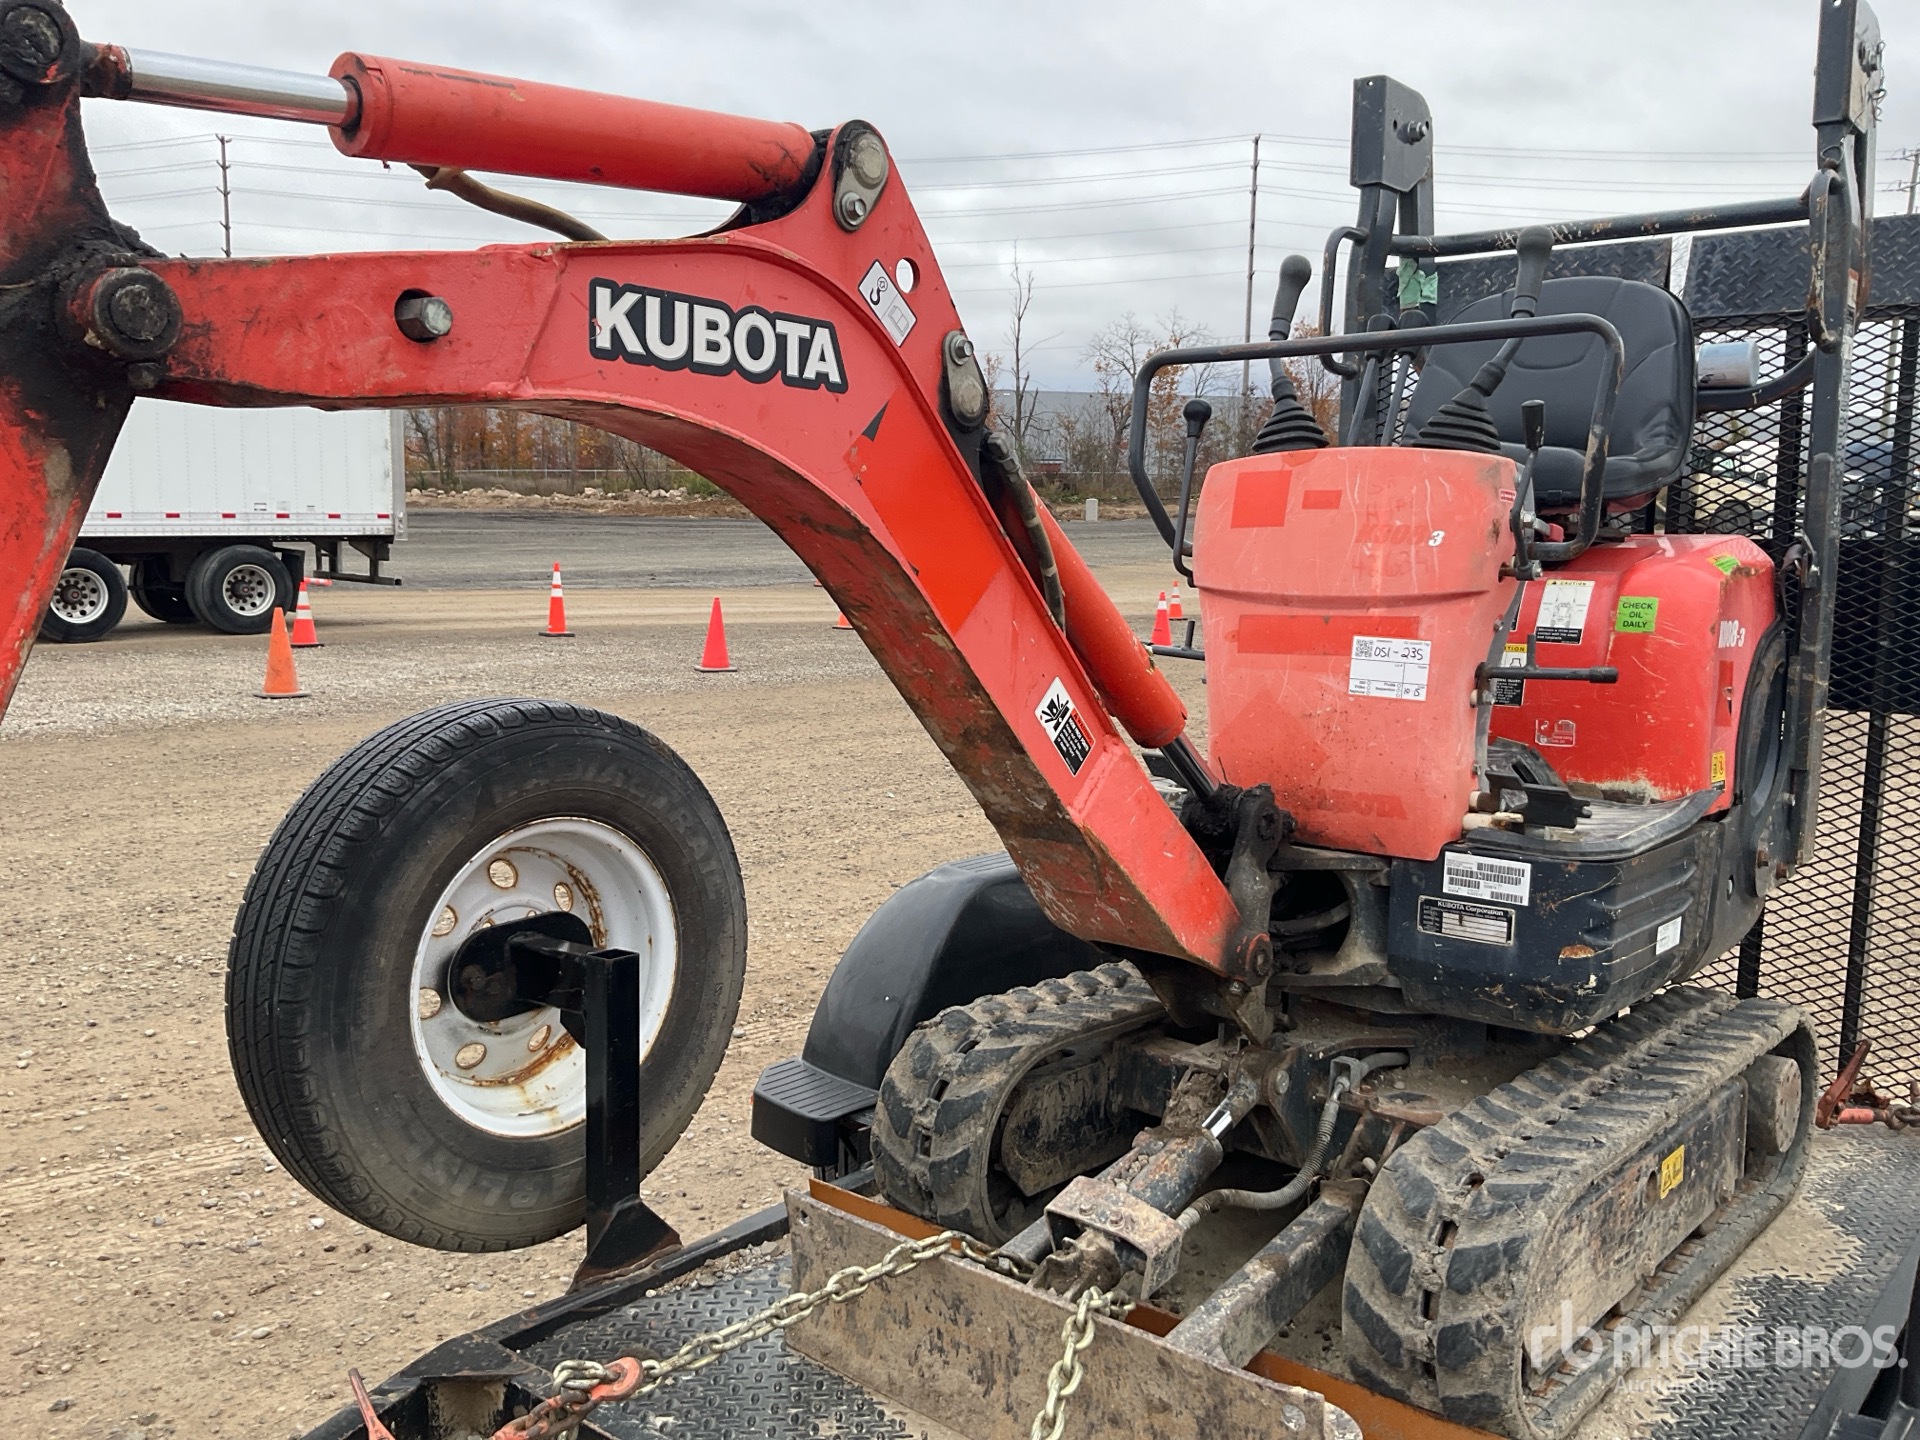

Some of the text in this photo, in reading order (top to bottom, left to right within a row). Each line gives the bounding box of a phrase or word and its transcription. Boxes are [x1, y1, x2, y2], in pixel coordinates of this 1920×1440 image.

[594, 285, 842, 385] KUBOTA
[1428, 530, 1445, 547] 3
[1622, 602, 1653, 610] CHECK
[1629, 611, 1643, 619] OIL
[1622, 620, 1648, 629] DAILY
[1437, 900, 1465, 911] KUBOTA
[1465, 904, 1504, 917] Corporation
